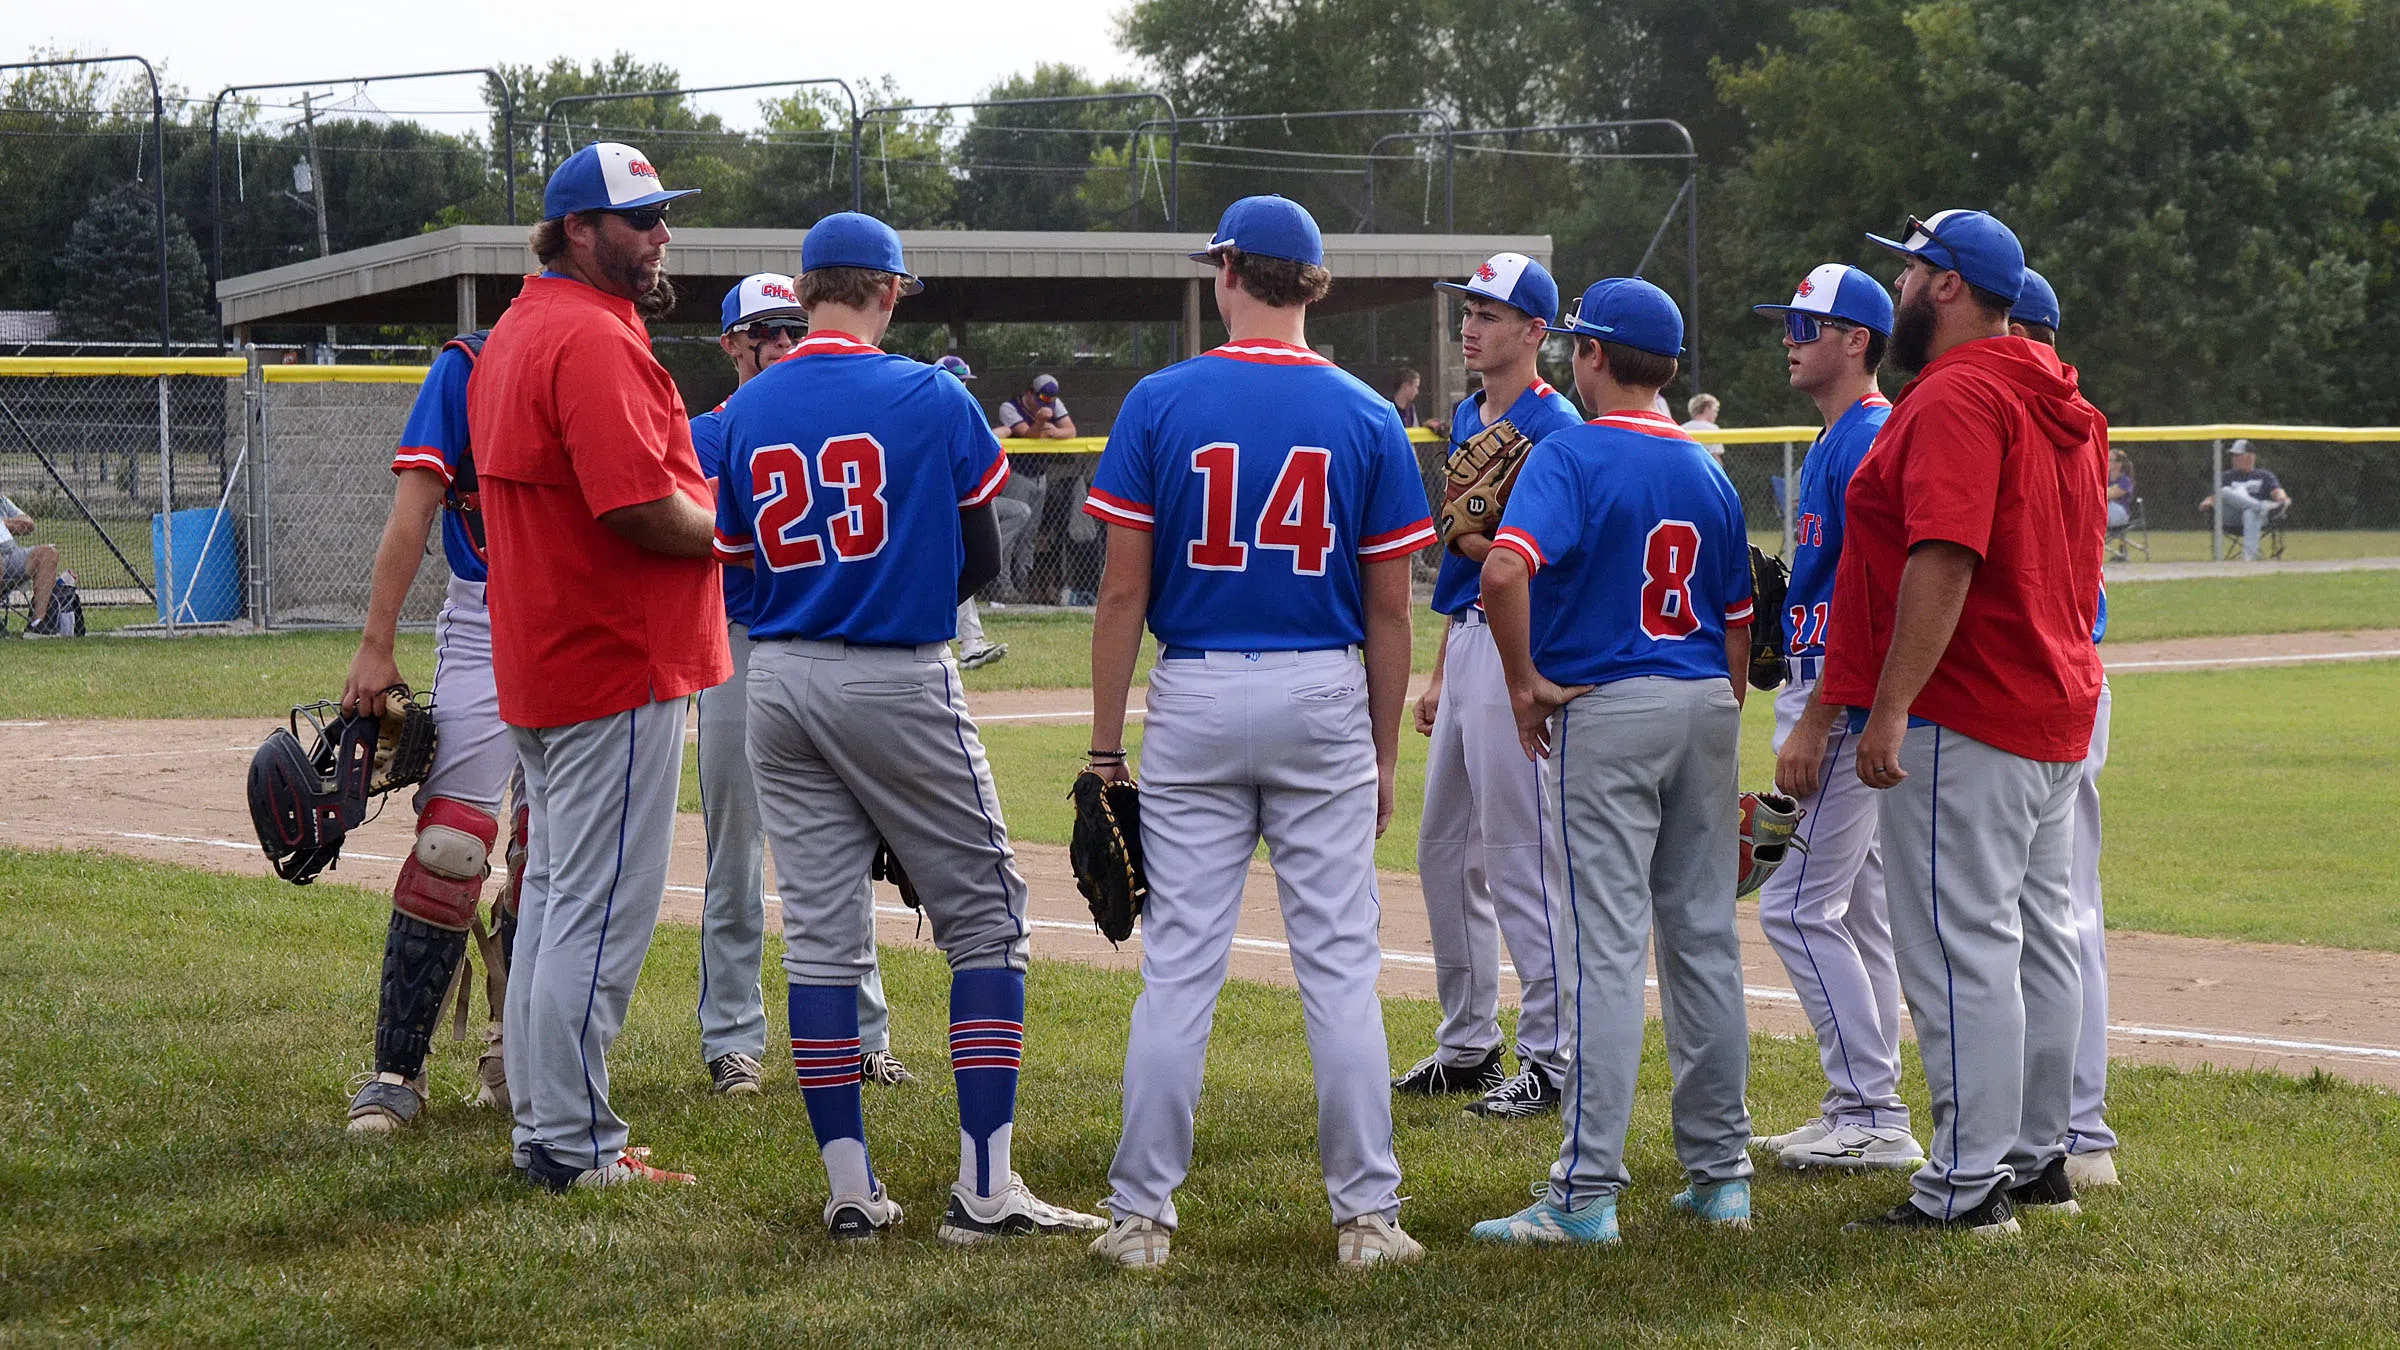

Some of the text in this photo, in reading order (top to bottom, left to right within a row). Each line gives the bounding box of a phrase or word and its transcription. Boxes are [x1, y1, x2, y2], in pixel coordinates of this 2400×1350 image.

[749, 432, 889, 573] 23
[1187, 441, 1336, 577] 14
[1797, 512, 1823, 548] TS
[1640, 519, 1702, 641] 8
[1790, 601, 1828, 655] 11
